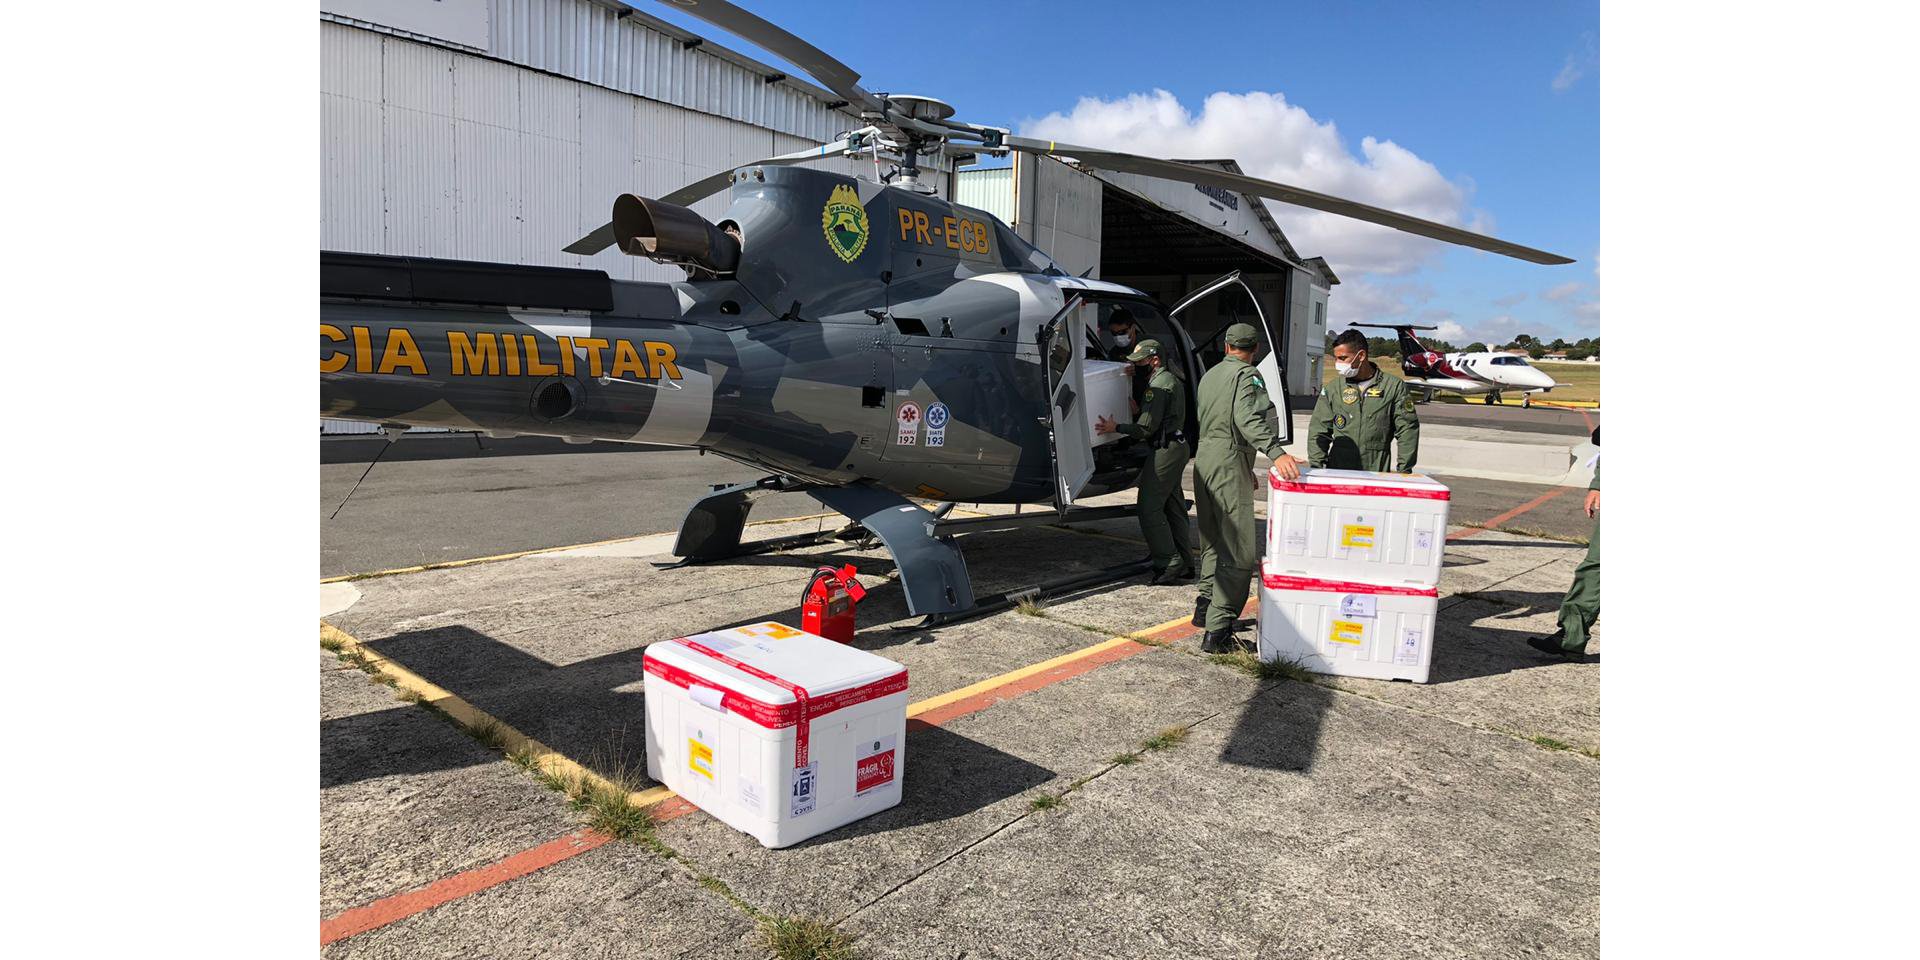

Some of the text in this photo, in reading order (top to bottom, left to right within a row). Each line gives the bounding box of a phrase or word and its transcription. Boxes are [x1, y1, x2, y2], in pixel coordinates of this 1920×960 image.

[898, 207, 990, 254] PR-ECB
[446, 330, 683, 380] MILITAR
[899, 436, 915, 444] 192
[927, 437, 944, 445] 193
[858, 762, 878, 777] FRÁGIL
